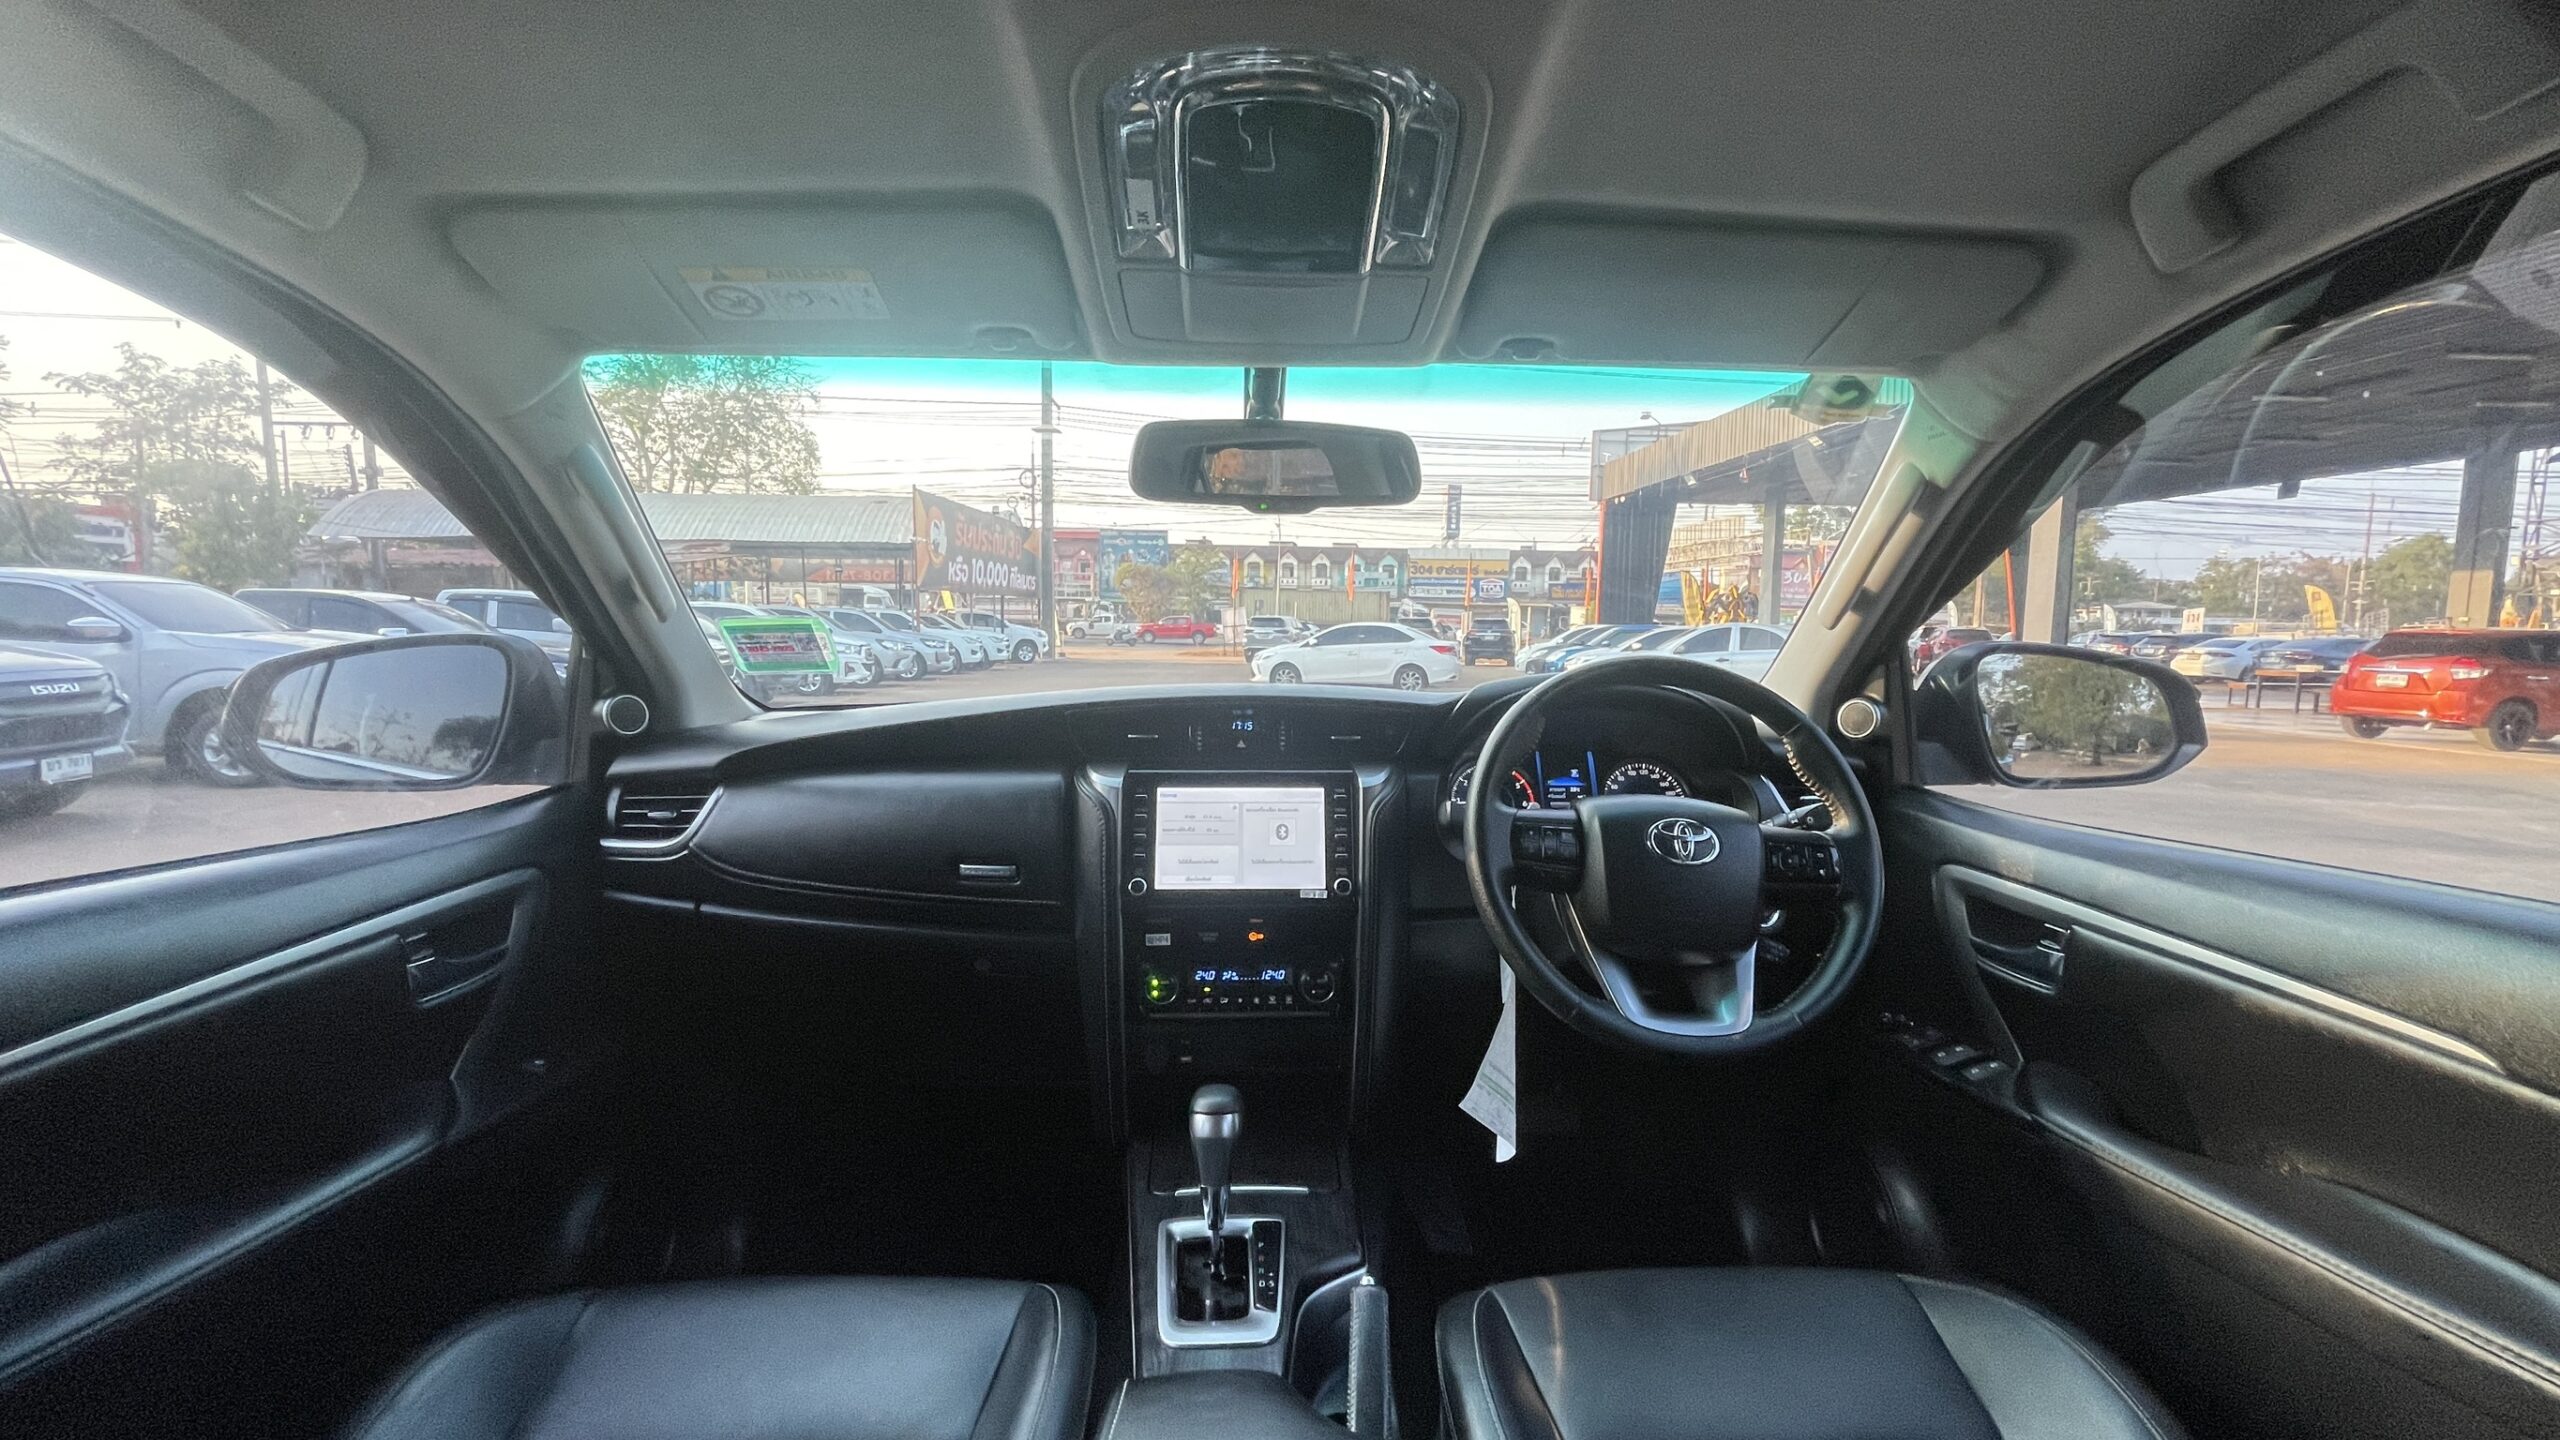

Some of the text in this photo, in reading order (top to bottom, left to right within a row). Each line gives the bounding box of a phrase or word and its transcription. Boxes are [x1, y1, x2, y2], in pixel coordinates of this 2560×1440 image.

[948, 555, 1037, 591] หรือ 10,000 กิโลเมตร
[1410, 565, 1433, 575] 304
[1481, 585, 1503, 593] TOA
[30, 682, 80, 696] ISUZU
